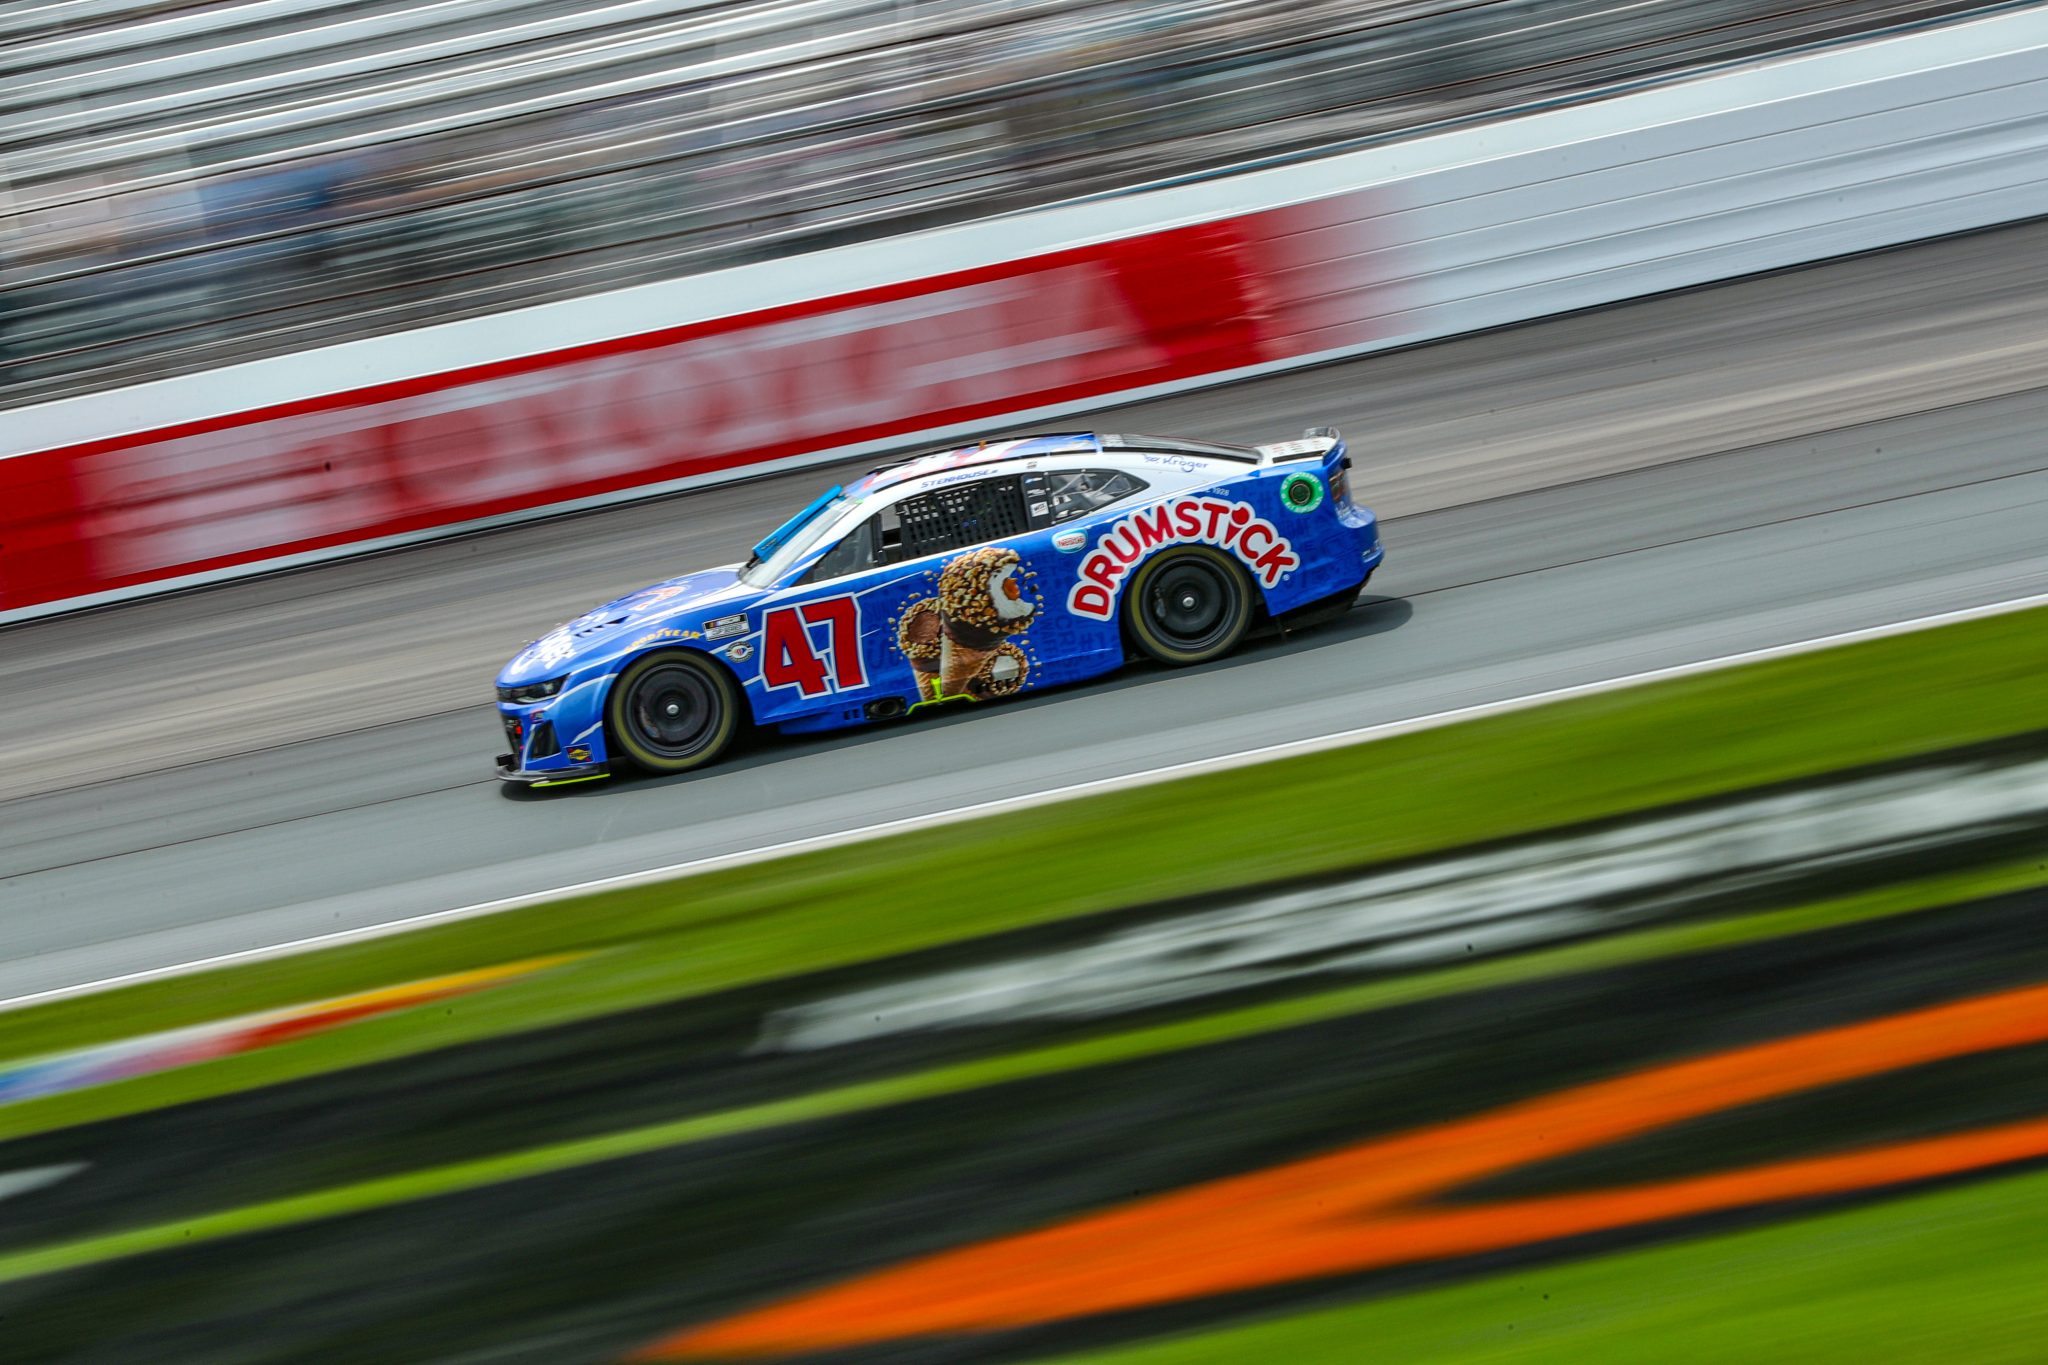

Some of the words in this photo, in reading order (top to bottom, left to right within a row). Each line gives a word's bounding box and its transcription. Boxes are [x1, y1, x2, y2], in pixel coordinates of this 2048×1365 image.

[1163, 455, 1209, 473] Kroger
[920, 470, 989, 489] STENHOUSE
[760, 592, 869, 699] 47
